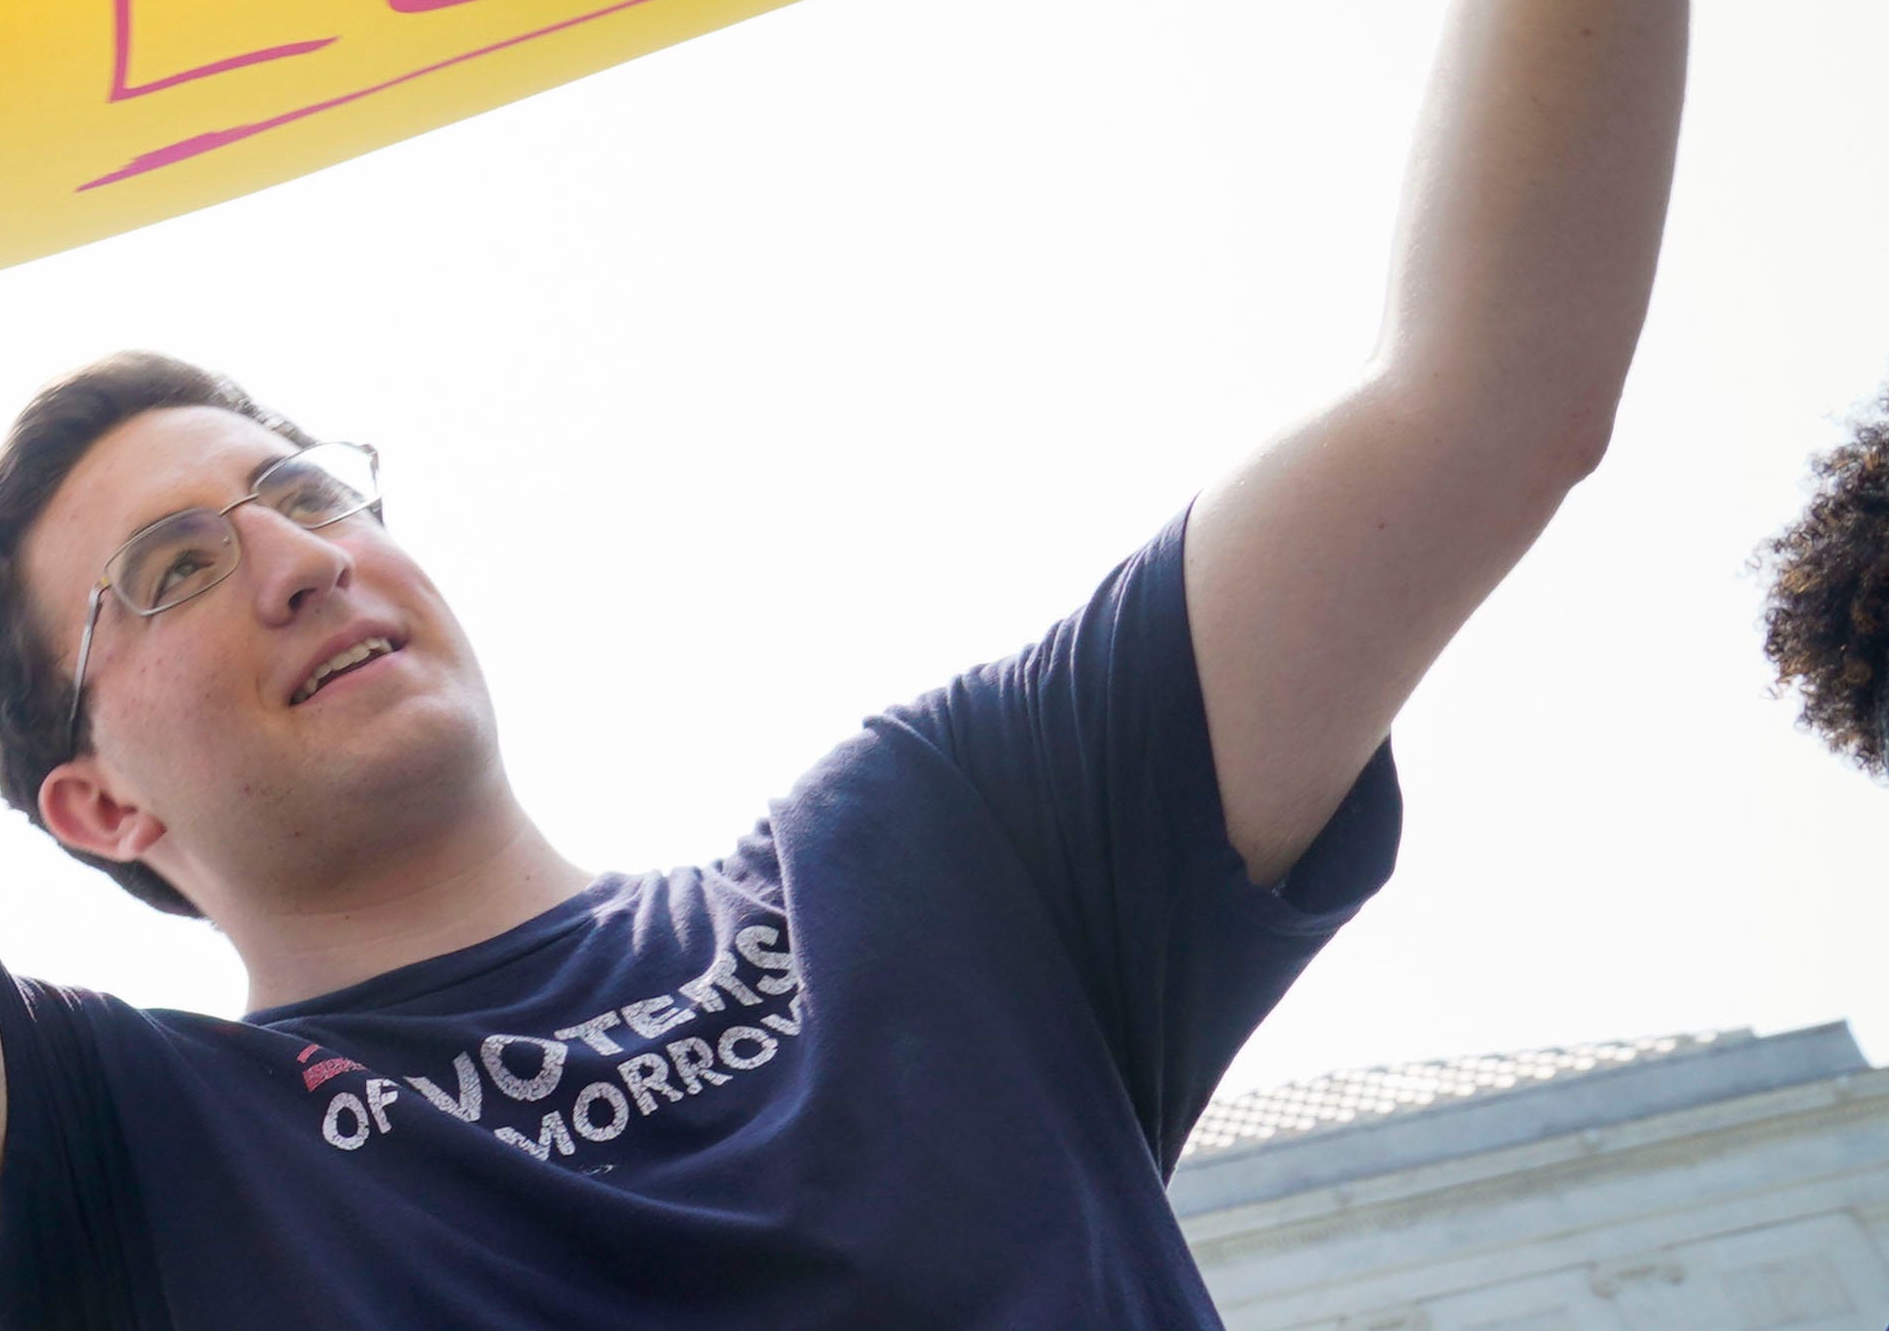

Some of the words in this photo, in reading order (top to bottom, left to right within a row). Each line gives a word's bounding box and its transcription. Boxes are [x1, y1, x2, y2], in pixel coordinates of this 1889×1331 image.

[321, 1077, 400, 1152] OF
[493, 993, 804, 1162] MORRO
[403, 924, 802, 1123] VOTERS
